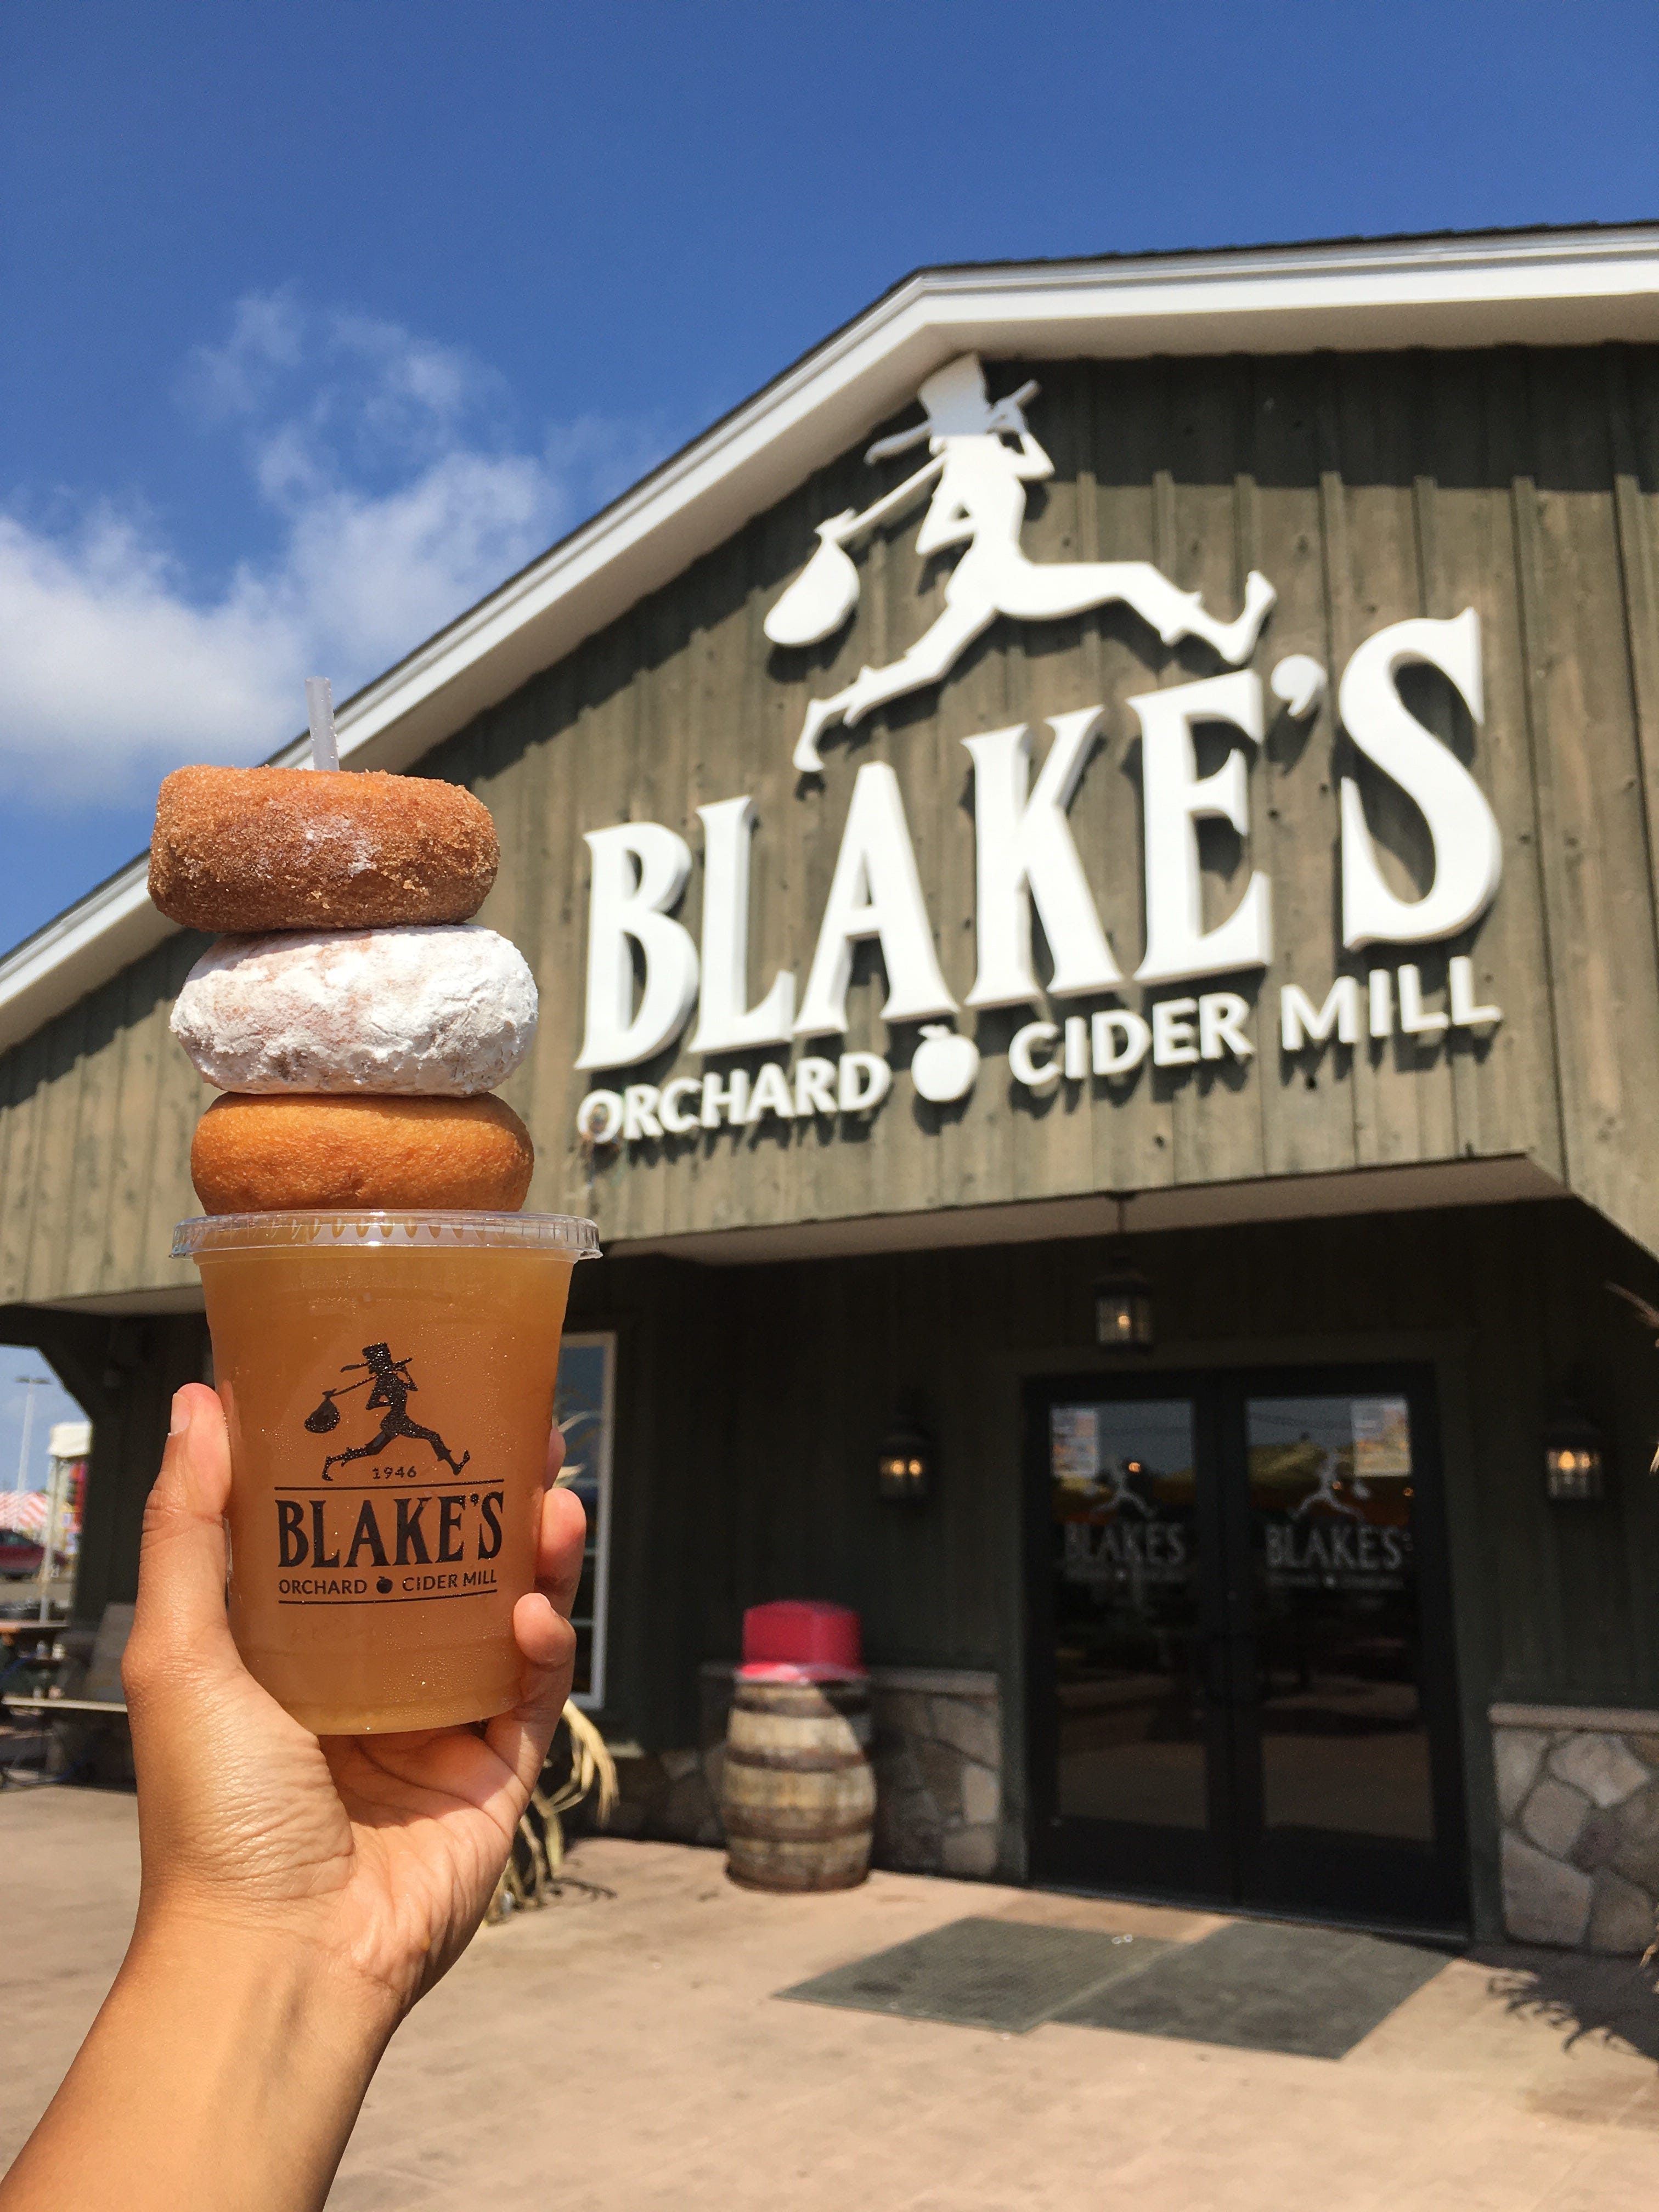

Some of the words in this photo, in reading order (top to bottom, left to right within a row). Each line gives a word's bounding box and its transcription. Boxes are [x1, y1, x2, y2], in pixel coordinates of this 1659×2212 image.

[575, 607, 1502, 1071] BLAKE'S
[577, 1050, 891, 1144] ORCHARD
[1008, 992, 1255, 1087] CIDER
[1280, 956, 1502, 1051] MILL
[372, 1466, 417, 1480] 1946
[275, 1491, 504, 1568] BLAKE'S
[279, 1579, 368, 1594] ORCHARD
[402, 1573, 458, 1592] CIDER
[462, 1569, 497, 1587] MILL
